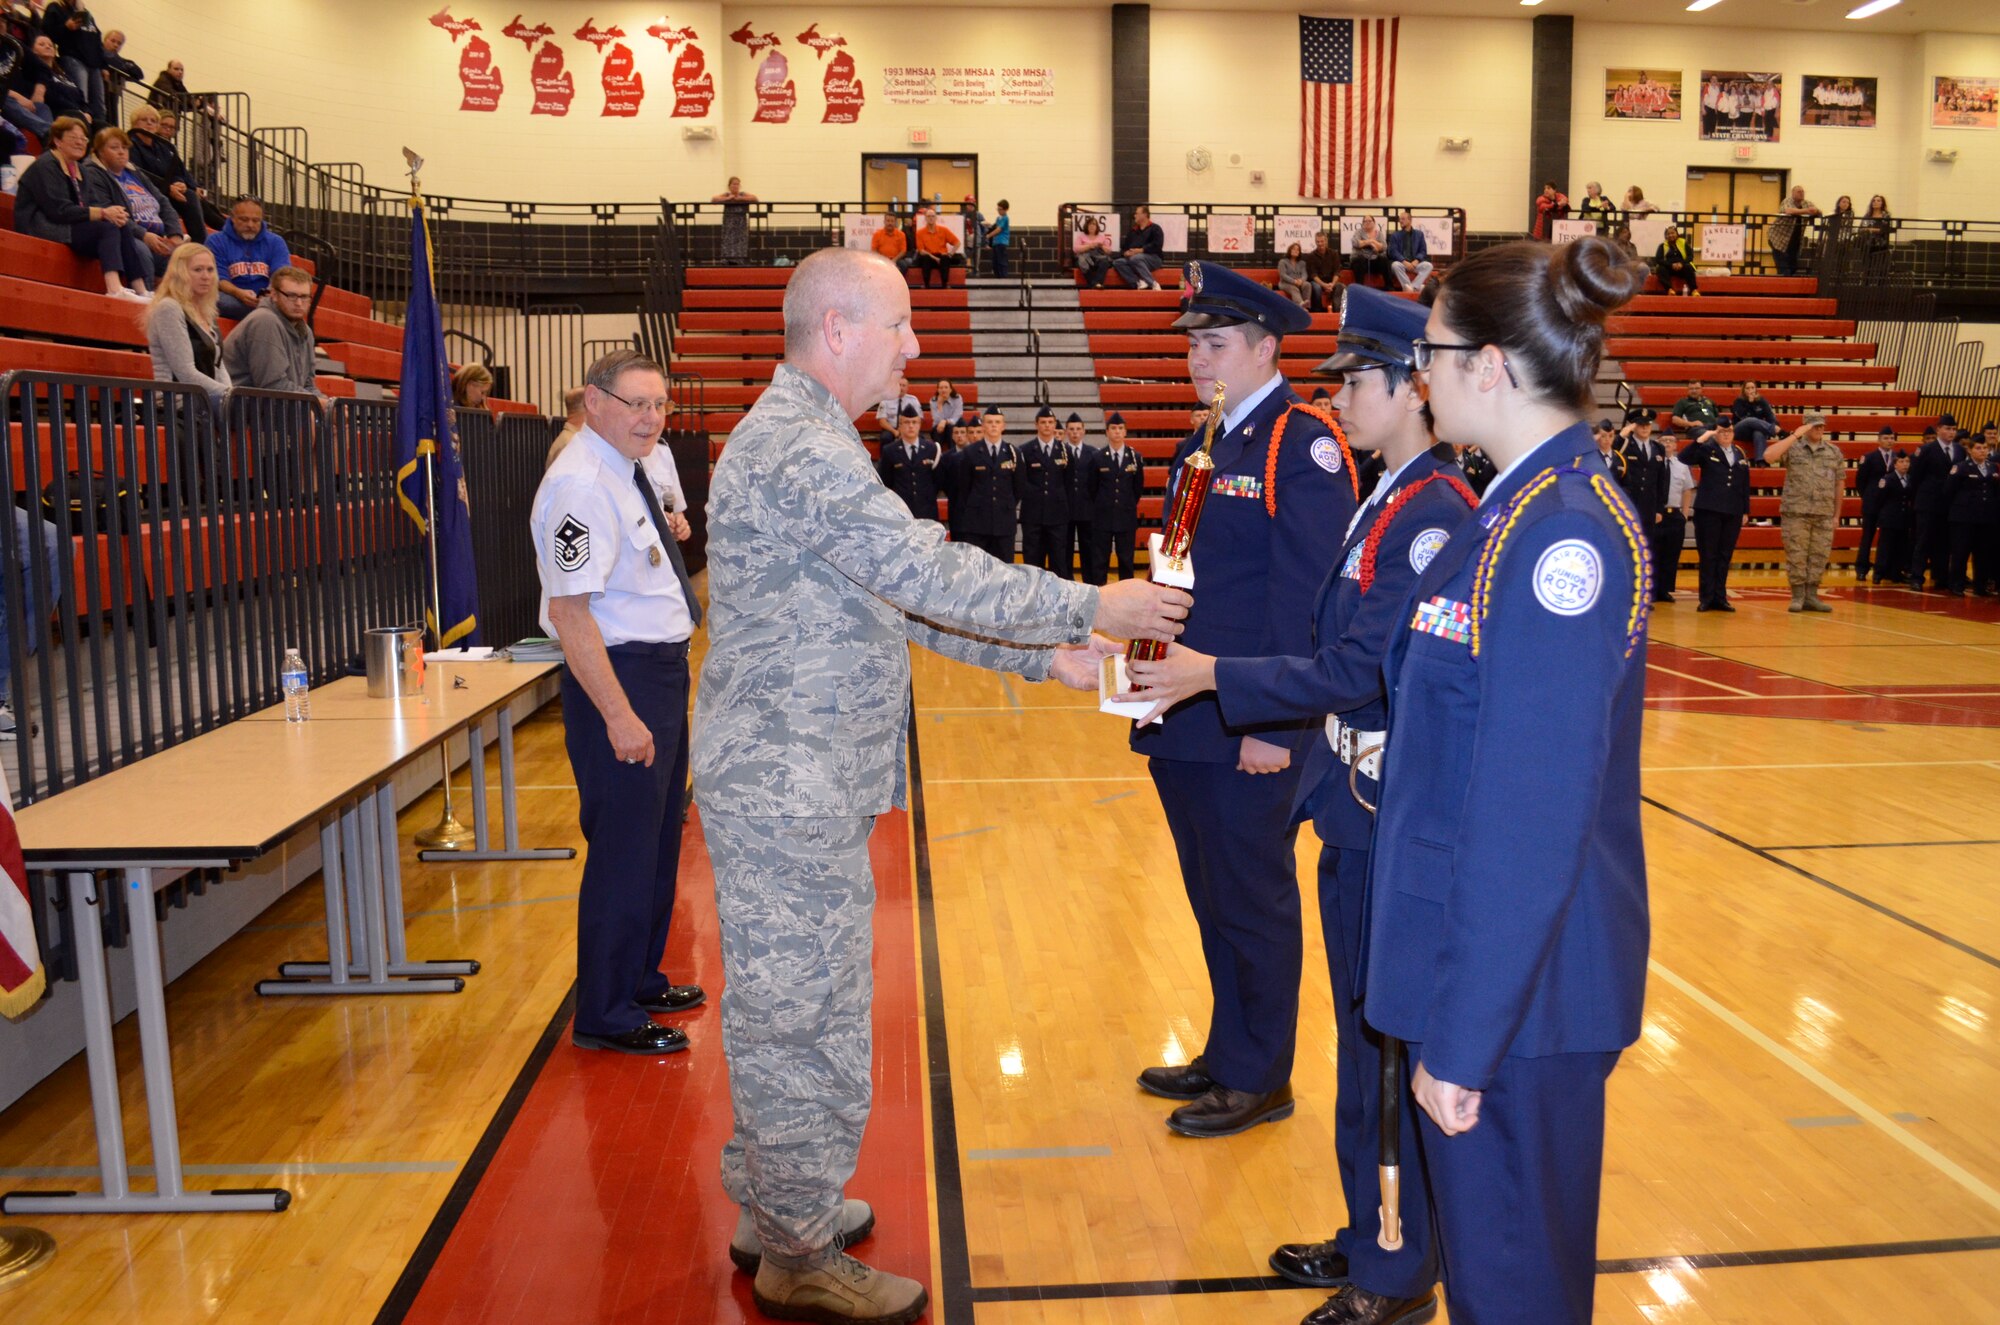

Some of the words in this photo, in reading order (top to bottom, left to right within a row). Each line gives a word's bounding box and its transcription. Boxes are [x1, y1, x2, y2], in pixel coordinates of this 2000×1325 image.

[514, 30, 542, 38] MHSAA
[660, 32, 686, 40] MHSAA
[746, 38, 773, 46] MHSAA
[808, 38, 834, 46] MHSAA
[904, 68, 936, 76] MHSAA
[964, 68, 996, 76] MHSAA
[1002, 68, 1020, 76] 2008
[1022, 68, 1053, 76] MHSAA
[676, 78, 710, 88] Softball
[762, 80, 782, 88] Girls
[828, 78, 848, 86] Girls
[1012, 79, 1043, 87] Softball
[758, 86, 792, 96] Bowling
[824, 84, 859, 95] Bowling
[676, 90, 713, 100] Runner-Up
[759, 98, 796, 107] Runner-Up
[1738, 146, 1750, 156] EXIT
[1342, 222, 1385, 232] MOY
[1704, 227, 1739, 236] JANELLE
[1284, 230, 1312, 238] AMELIA
[1222, 237, 1239, 250] 22
[1318, 454, 1338, 463] ROTC
[1420, 536, 1432, 546] AIR
[1553, 550, 1570, 562] AIR
[1574, 551, 1594, 578] FORCE
[1552, 568, 1586, 586] JUNIOR
[1544, 574, 1588, 598] ROTC
